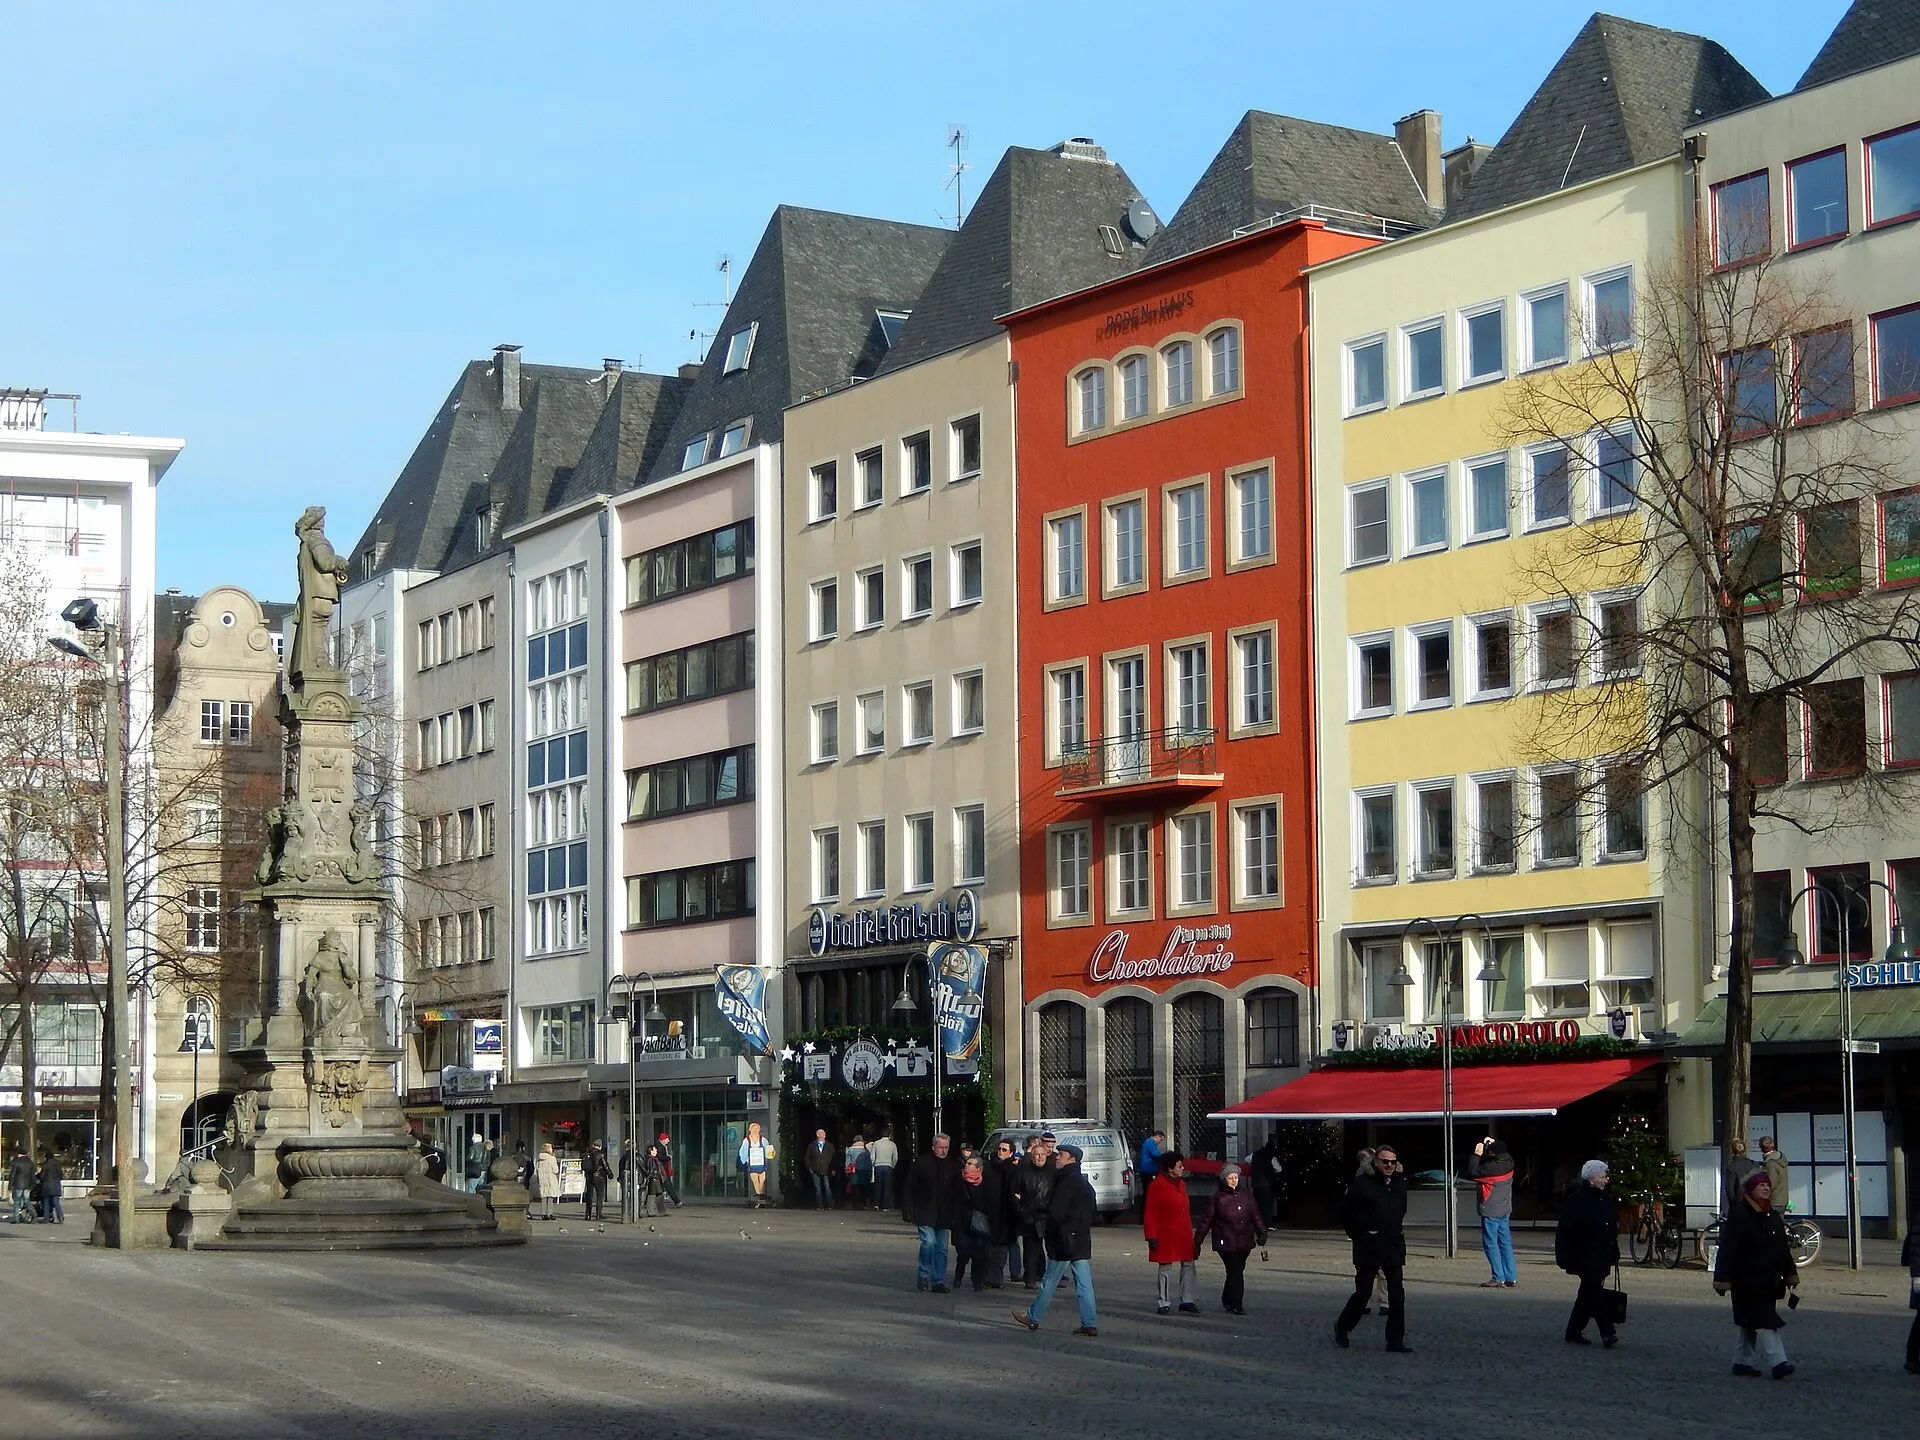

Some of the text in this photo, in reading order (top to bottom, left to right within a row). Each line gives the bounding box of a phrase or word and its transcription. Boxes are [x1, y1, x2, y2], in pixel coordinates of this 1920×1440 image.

[1090, 925, 1233, 982] Chocolaterie
[476, 1029, 500, 1045] Sion
[1434, 1022, 1515, 1048] MARCO
[1515, 1019, 1578, 1045] POLO
